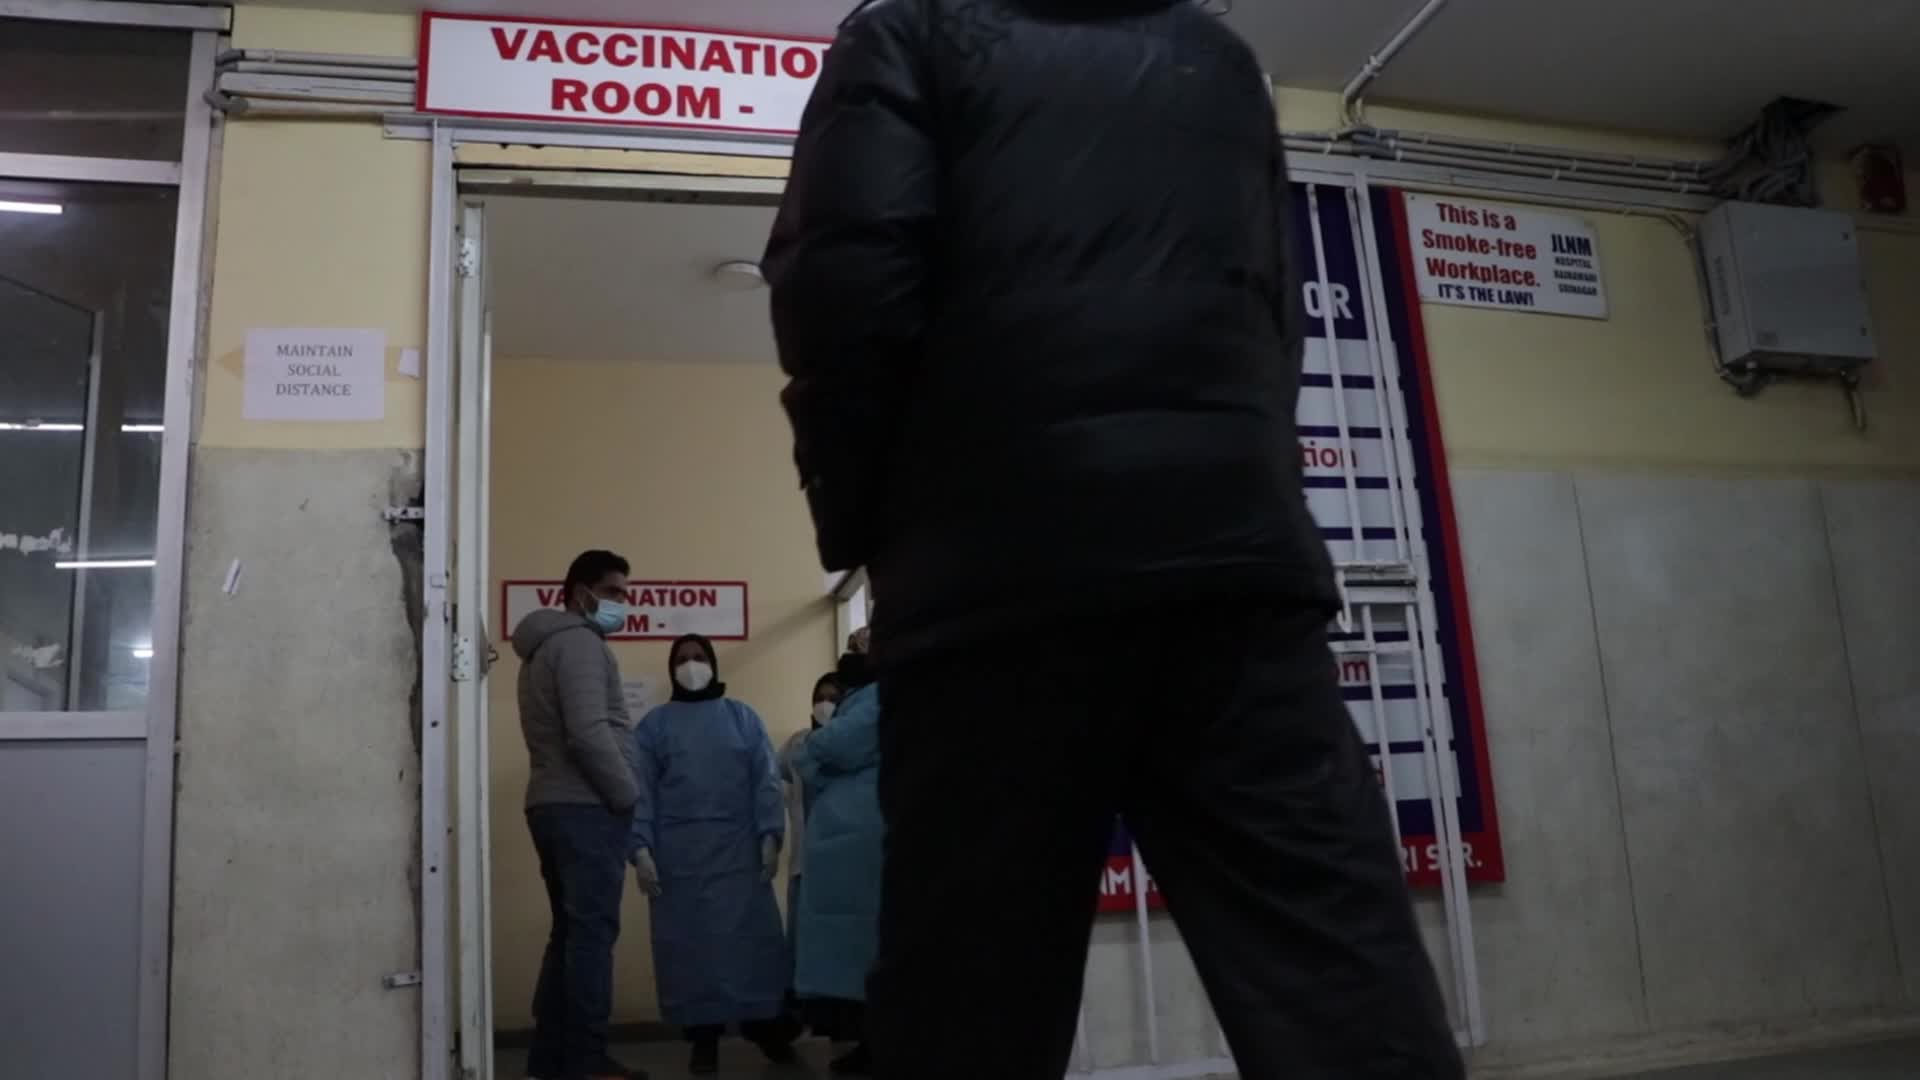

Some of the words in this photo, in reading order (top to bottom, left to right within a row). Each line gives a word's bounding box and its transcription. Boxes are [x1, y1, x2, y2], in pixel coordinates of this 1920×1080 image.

[551, 78, 721, 119] ROOM
[1436, 203, 1478, 226] This
[1483, 209, 1500, 229] is
[1504, 215, 1516, 231] a
[1422, 229, 1537, 260] Smoke-free
[1551, 233, 1593, 257] JLNM
[1425, 257, 1541, 288] Workplace.
[1438, 283, 1465, 300] IT'S
[1468, 286, 1494, 303] THE
[1498, 290, 1535, 306] LAW!
[276, 344, 353, 358] MAINTAIN
[287, 364, 342, 377] SOCIAL
[275, 383, 352, 397] DISTANCE
